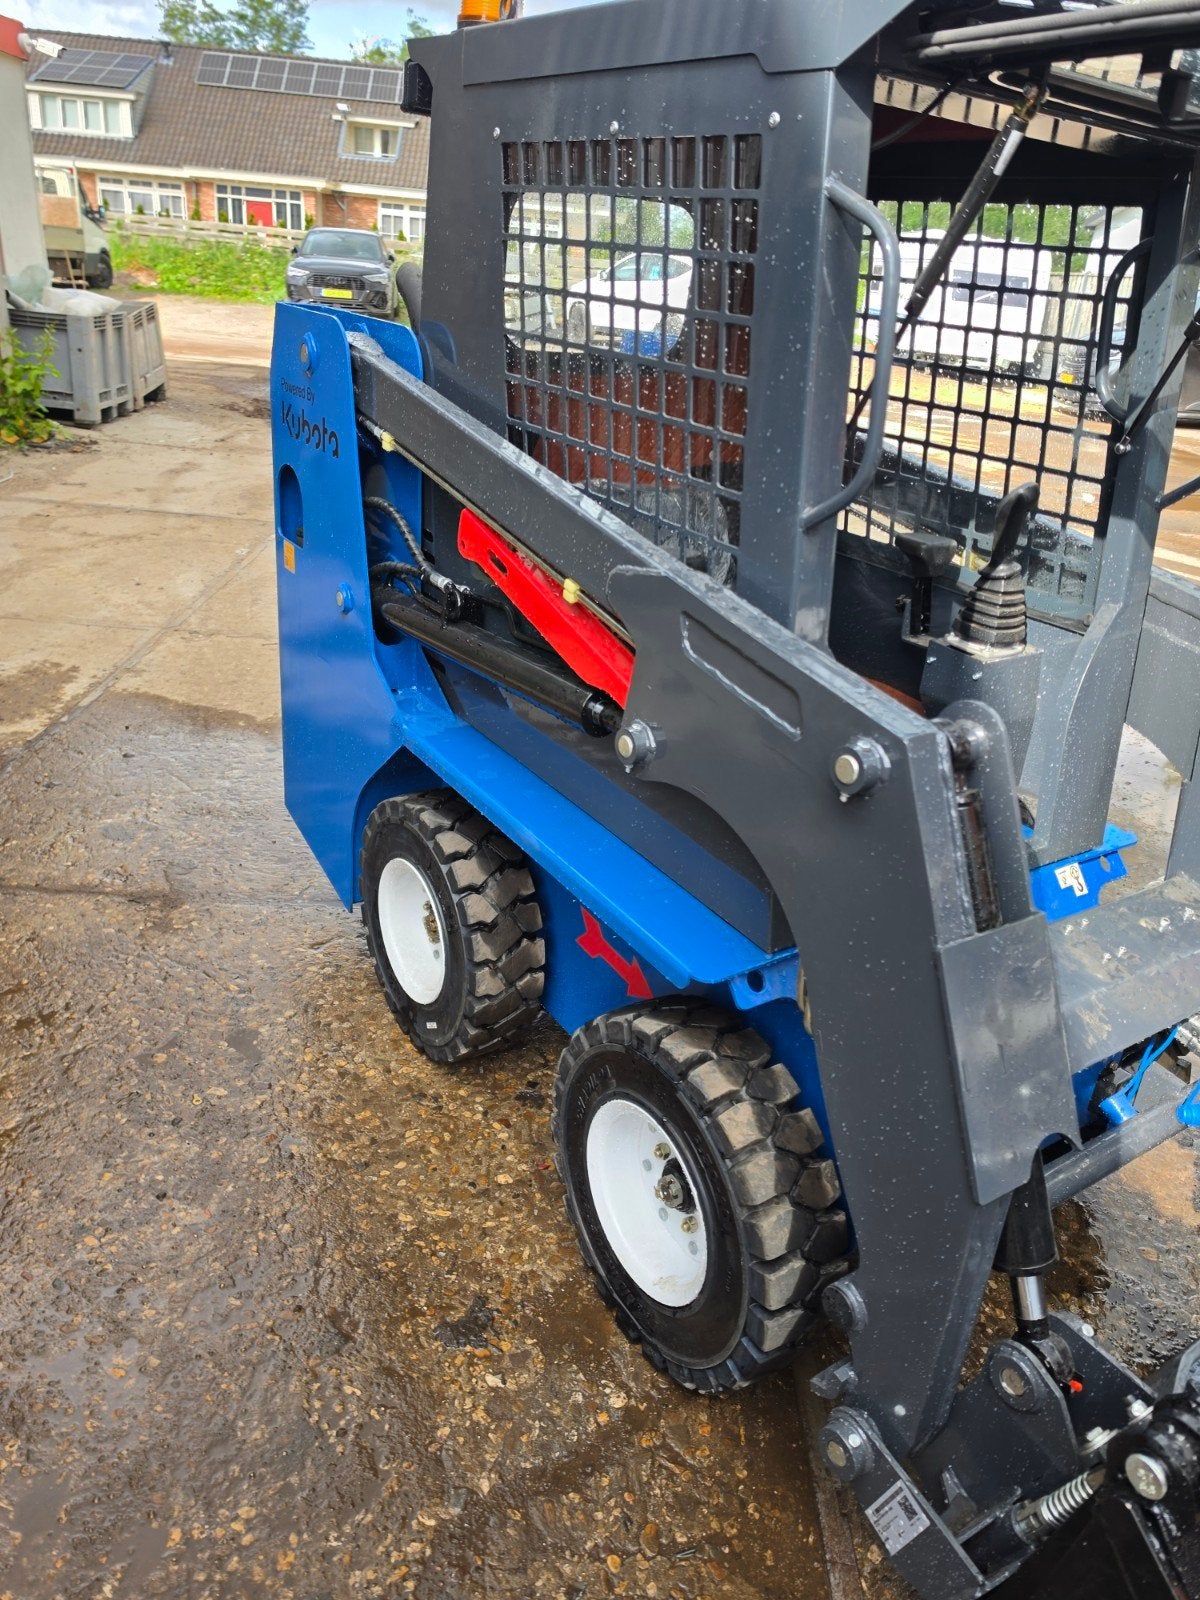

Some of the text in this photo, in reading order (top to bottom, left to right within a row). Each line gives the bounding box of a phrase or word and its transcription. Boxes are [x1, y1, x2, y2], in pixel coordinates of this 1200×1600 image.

[281, 377, 315, 406] Powered By
[281, 400, 339, 459] Kubota
